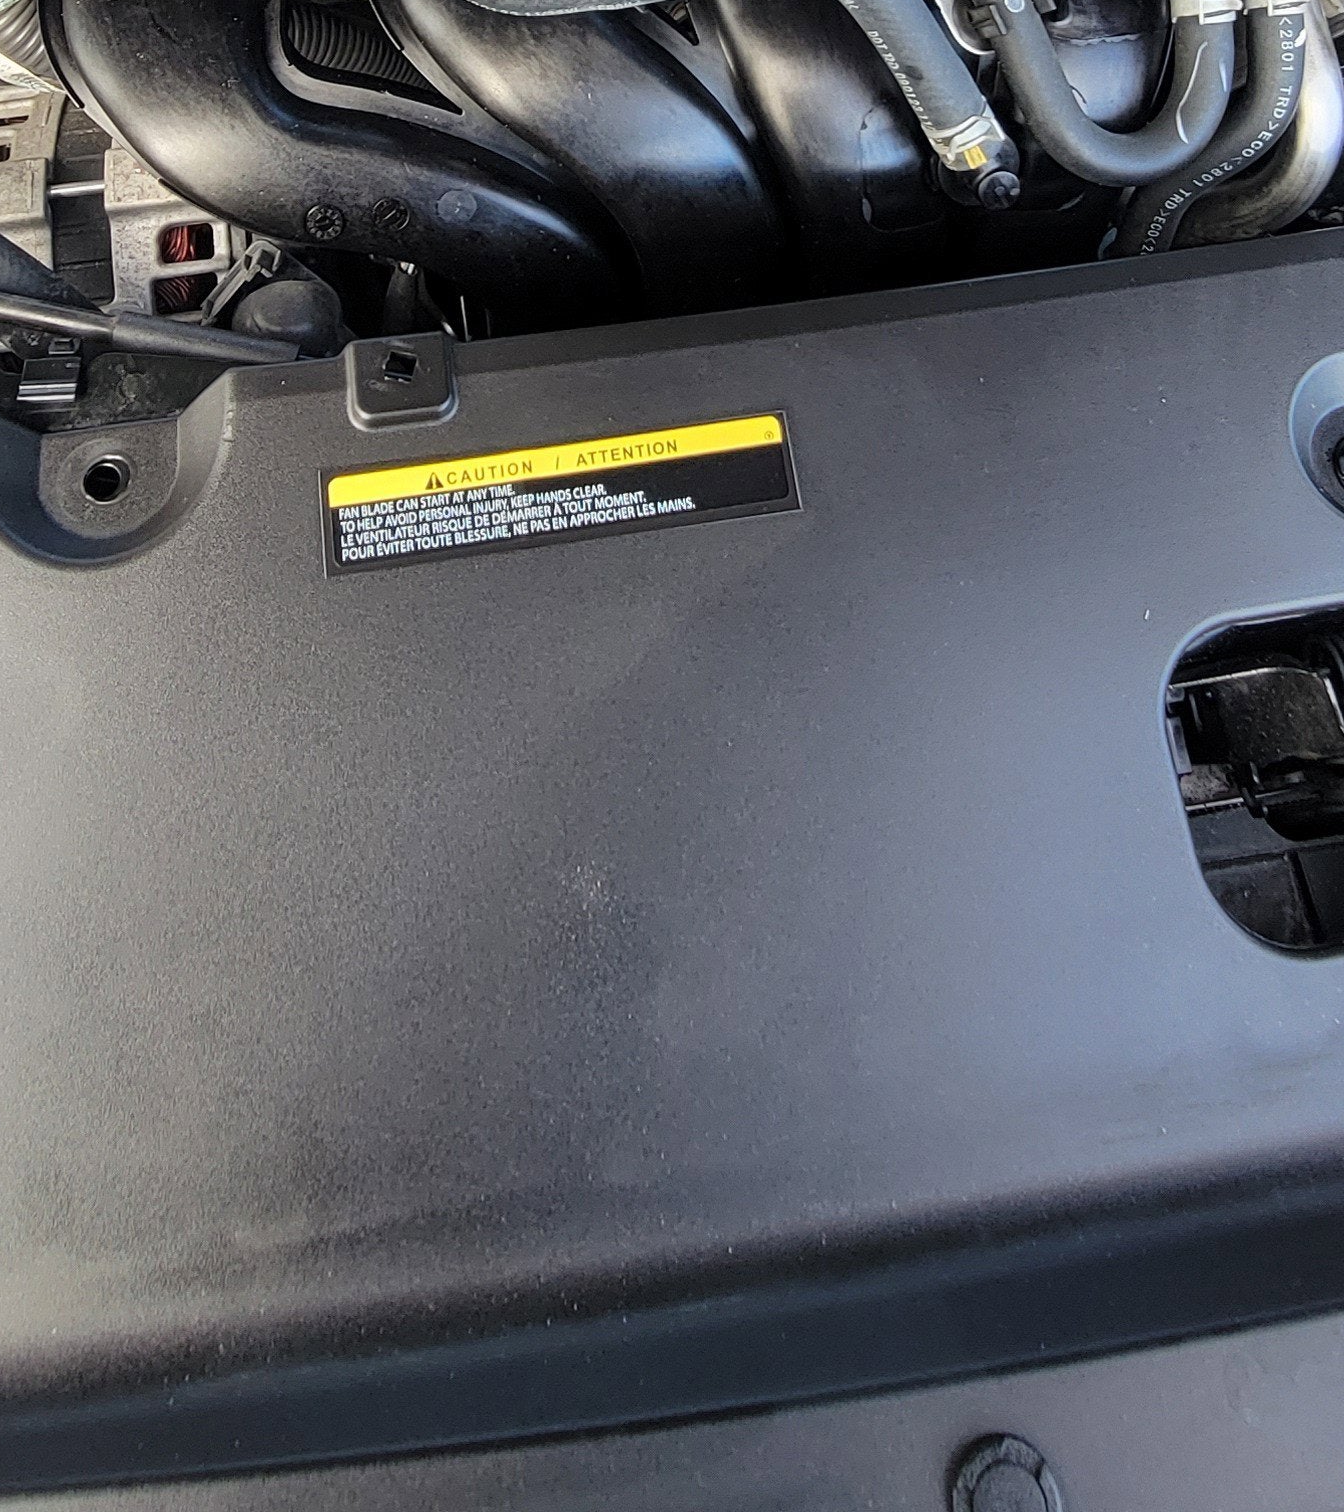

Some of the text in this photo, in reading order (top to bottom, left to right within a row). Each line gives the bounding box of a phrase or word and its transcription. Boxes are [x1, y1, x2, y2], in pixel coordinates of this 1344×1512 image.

[867, 31, 888, 50] DOT
[447, 460, 533, 485] CAUTION
[576, 439, 678, 467] ATTENTION
[338, 484, 516, 521] FAN BLADE CAN START AT ANY TIME.
[340, 484, 607, 534] TO HELP AVOID PERSONAL INJURY, KEEP HANDS CLEAR.
[340, 534, 355, 548] LE
[355, 524, 431, 546] VENTILATEUR
[432, 518, 472, 536] RISQUE
[474, 514, 489, 529] DE
[491, 504, 552, 526] DÉMARRER
[562, 499, 593, 516] TOUT
[594, 490, 647, 510] MOMENT.
[341, 496, 696, 562] POUR ÉVITER TOUTE BLESSURE, NE PAS EN APPROCHER LES MAINS.
